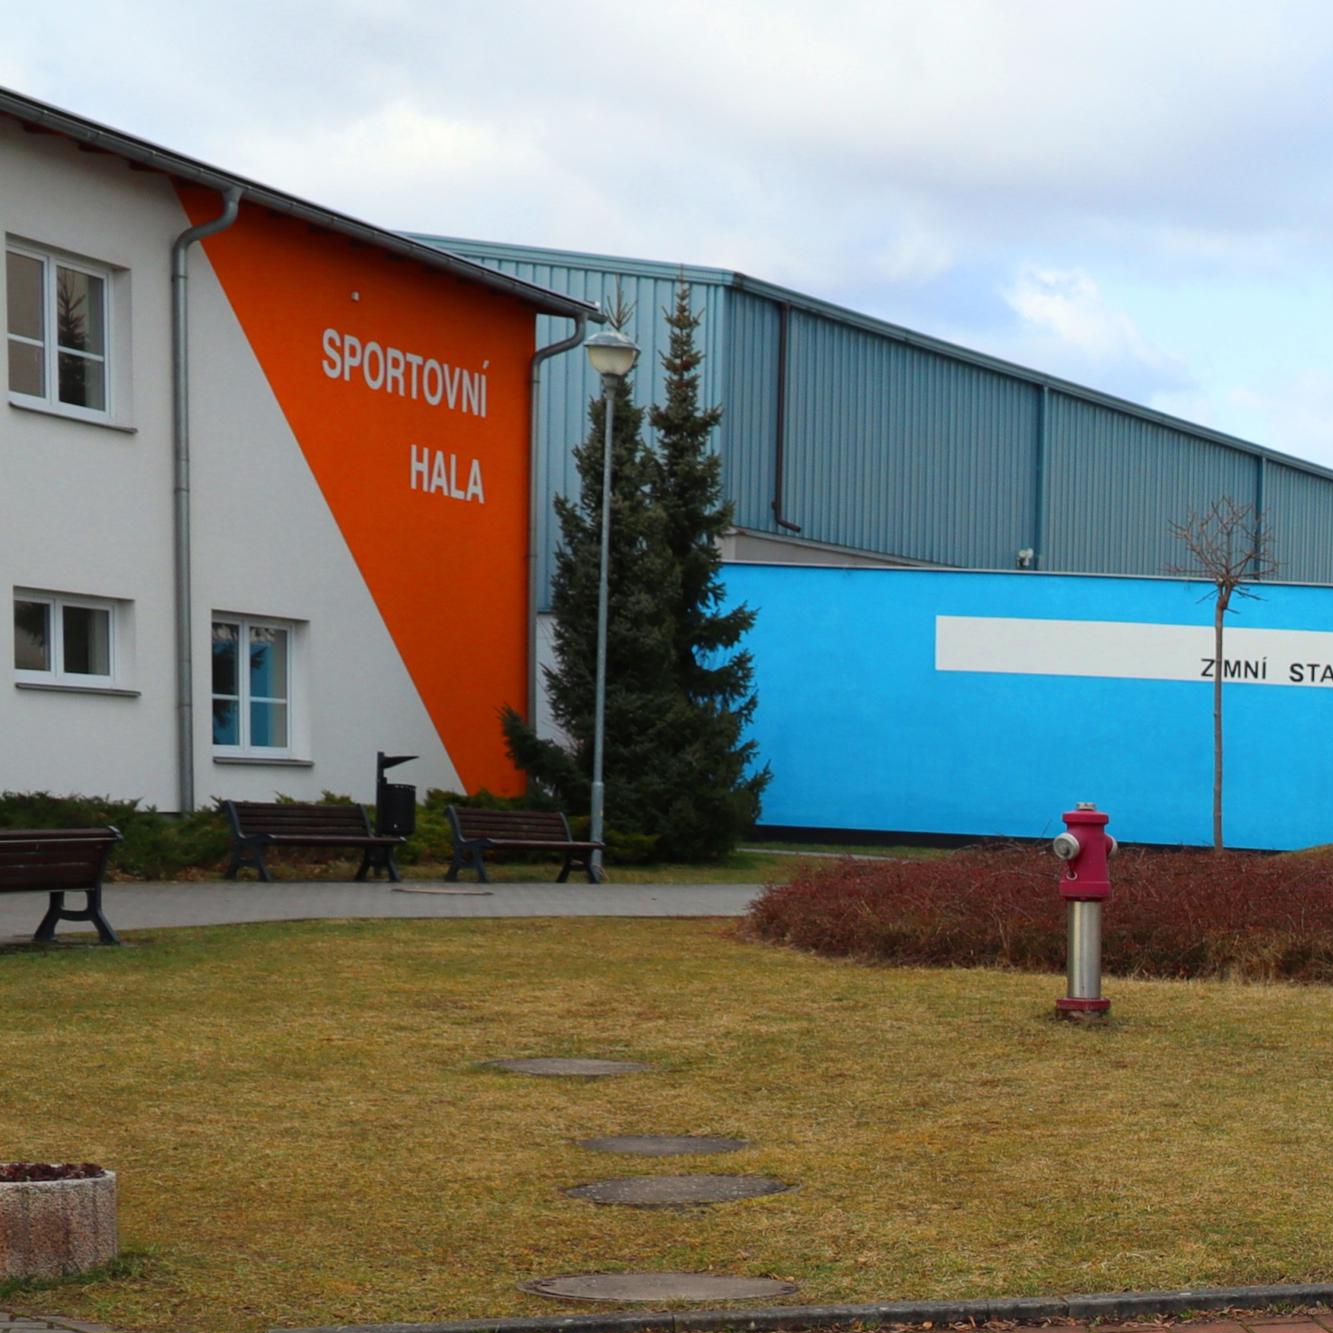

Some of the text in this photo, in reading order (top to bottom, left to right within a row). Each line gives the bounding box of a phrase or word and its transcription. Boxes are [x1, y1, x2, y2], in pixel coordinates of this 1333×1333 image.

[322, 328, 489, 418] SPORTOVNÍ
[410, 444, 485, 504] HALA
[1201, 656, 1268, 679] ZMNÍ
